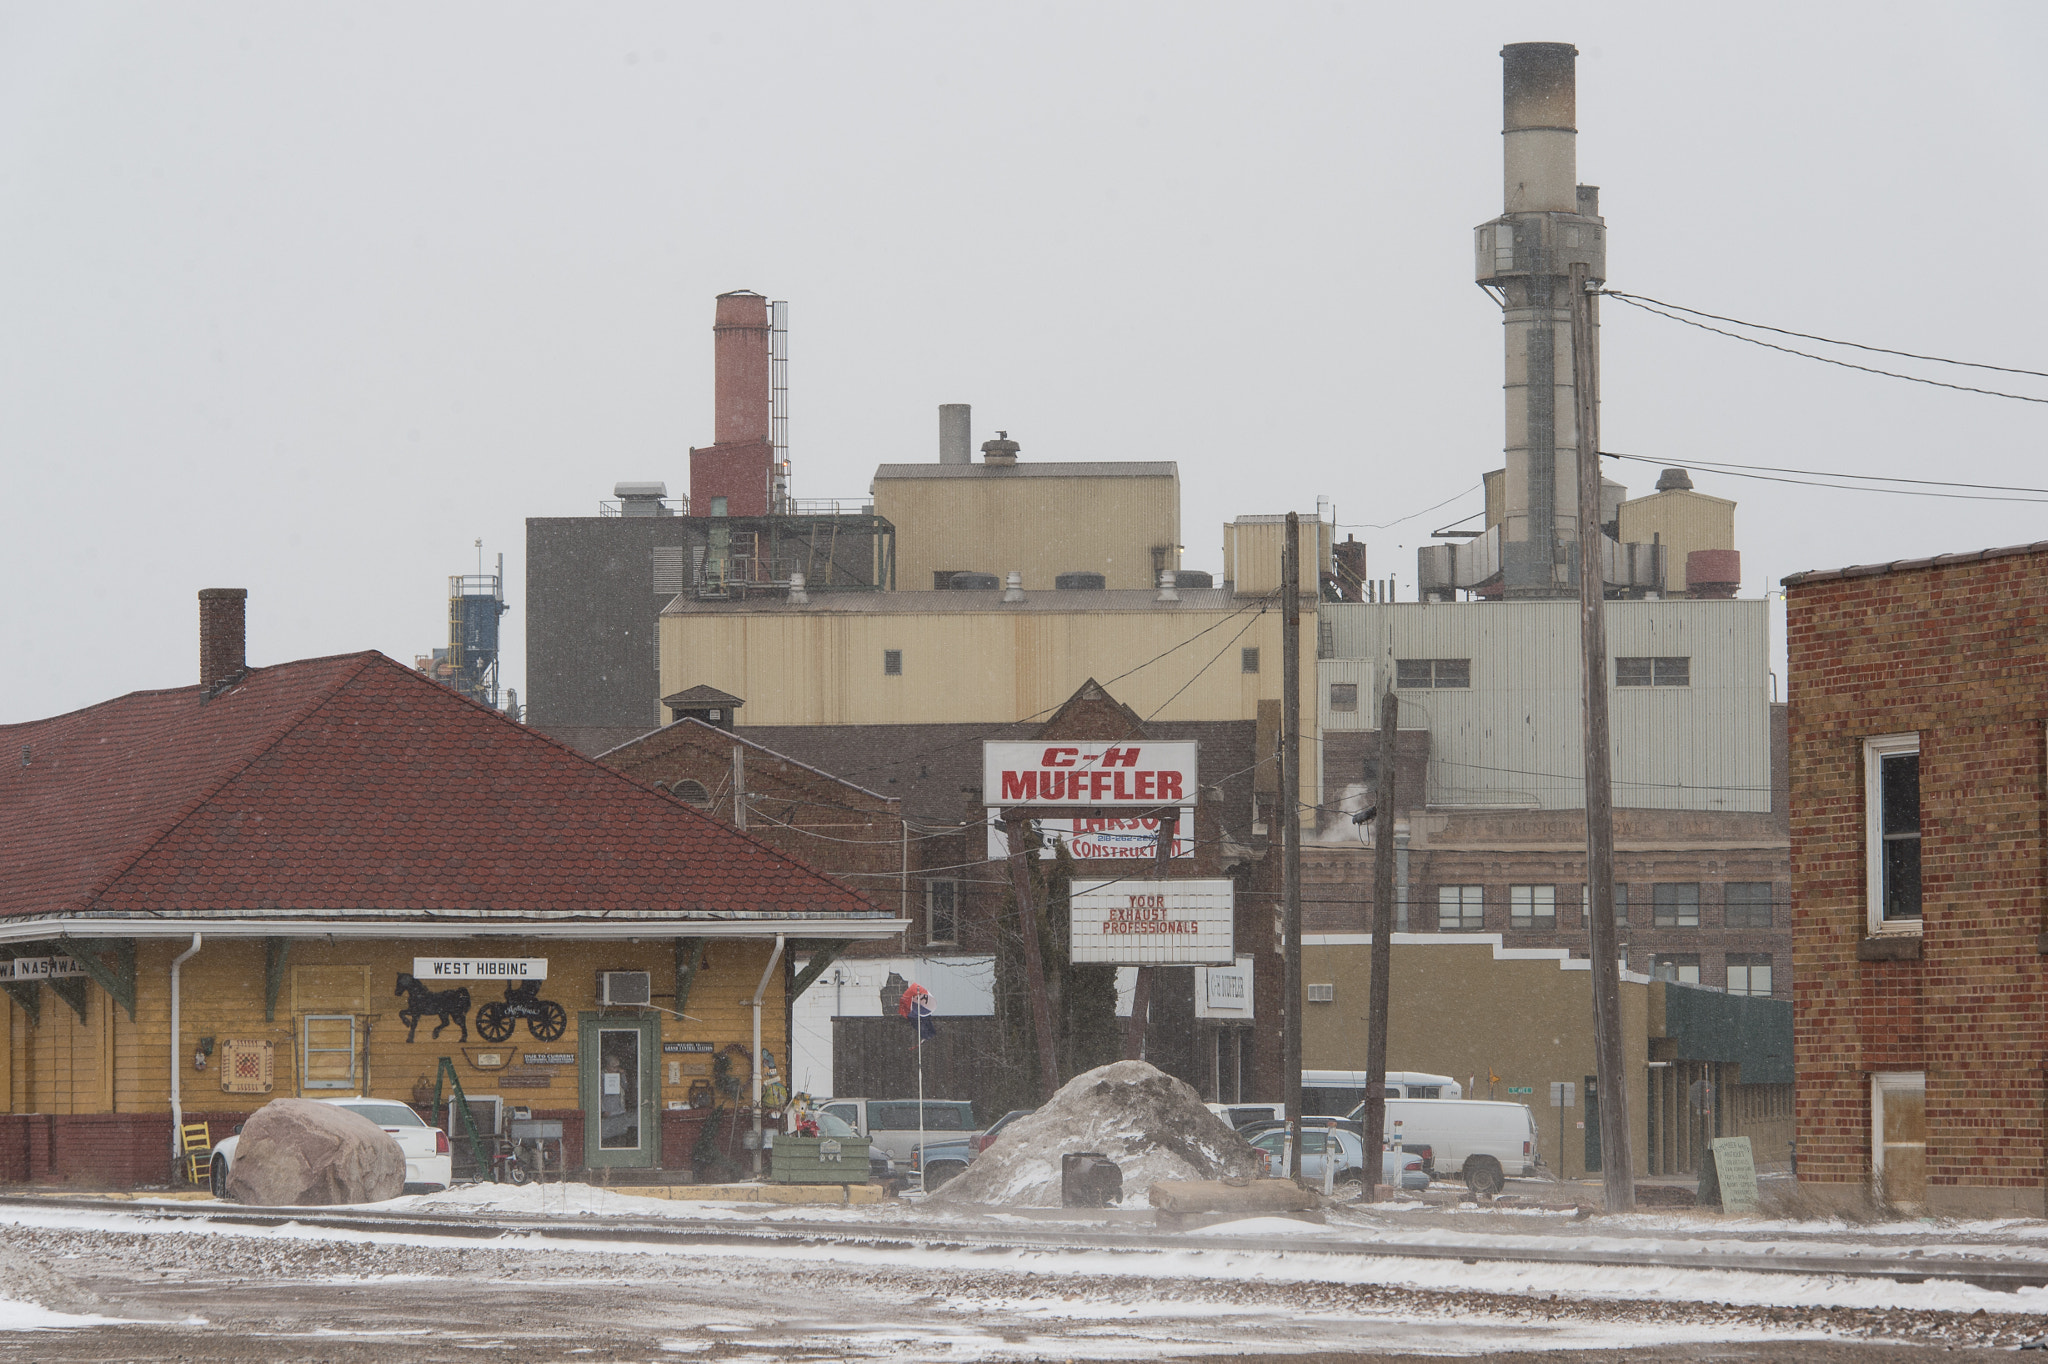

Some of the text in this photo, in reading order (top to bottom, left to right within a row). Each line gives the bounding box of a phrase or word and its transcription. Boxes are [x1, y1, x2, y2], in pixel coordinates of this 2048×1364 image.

[1041, 747, 1141, 767] C-H
[1001, 770, 1183, 800] MUFFLER
[1073, 818, 1180, 837] LARSO
[1510, 820, 1713, 833] MUNICIPAL OWER PLANT
[1072, 839, 1181, 858] CONSTRUCTN
[1129, 896, 1164, 907] YOUR
[1110, 909, 1167, 921] EXHAUST
[1103, 922, 1198, 934] PROFESSIONALS
[433, 962, 528, 975] WEST HIBBING
